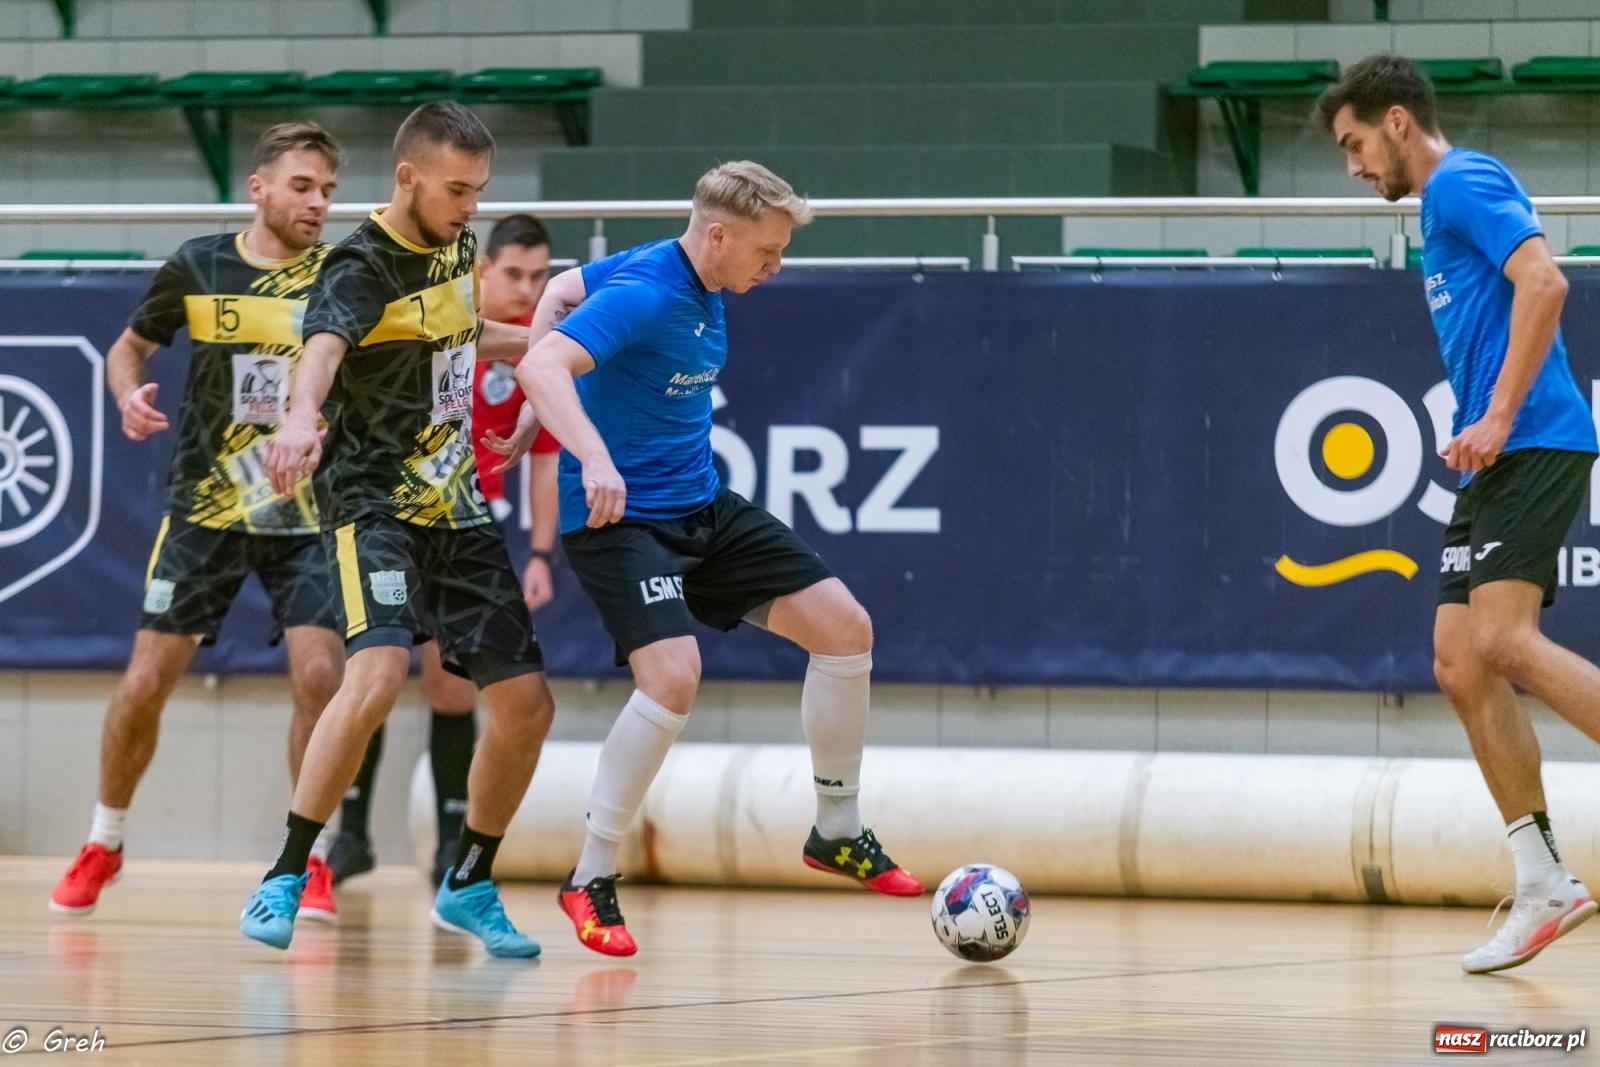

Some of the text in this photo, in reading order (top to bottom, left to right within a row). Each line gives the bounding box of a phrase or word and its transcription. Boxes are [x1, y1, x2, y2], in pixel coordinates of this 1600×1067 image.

[213, 298, 240, 332] 15
[410, 295, 425, 328] 7
[980, 891, 1010, 941] SELECT
